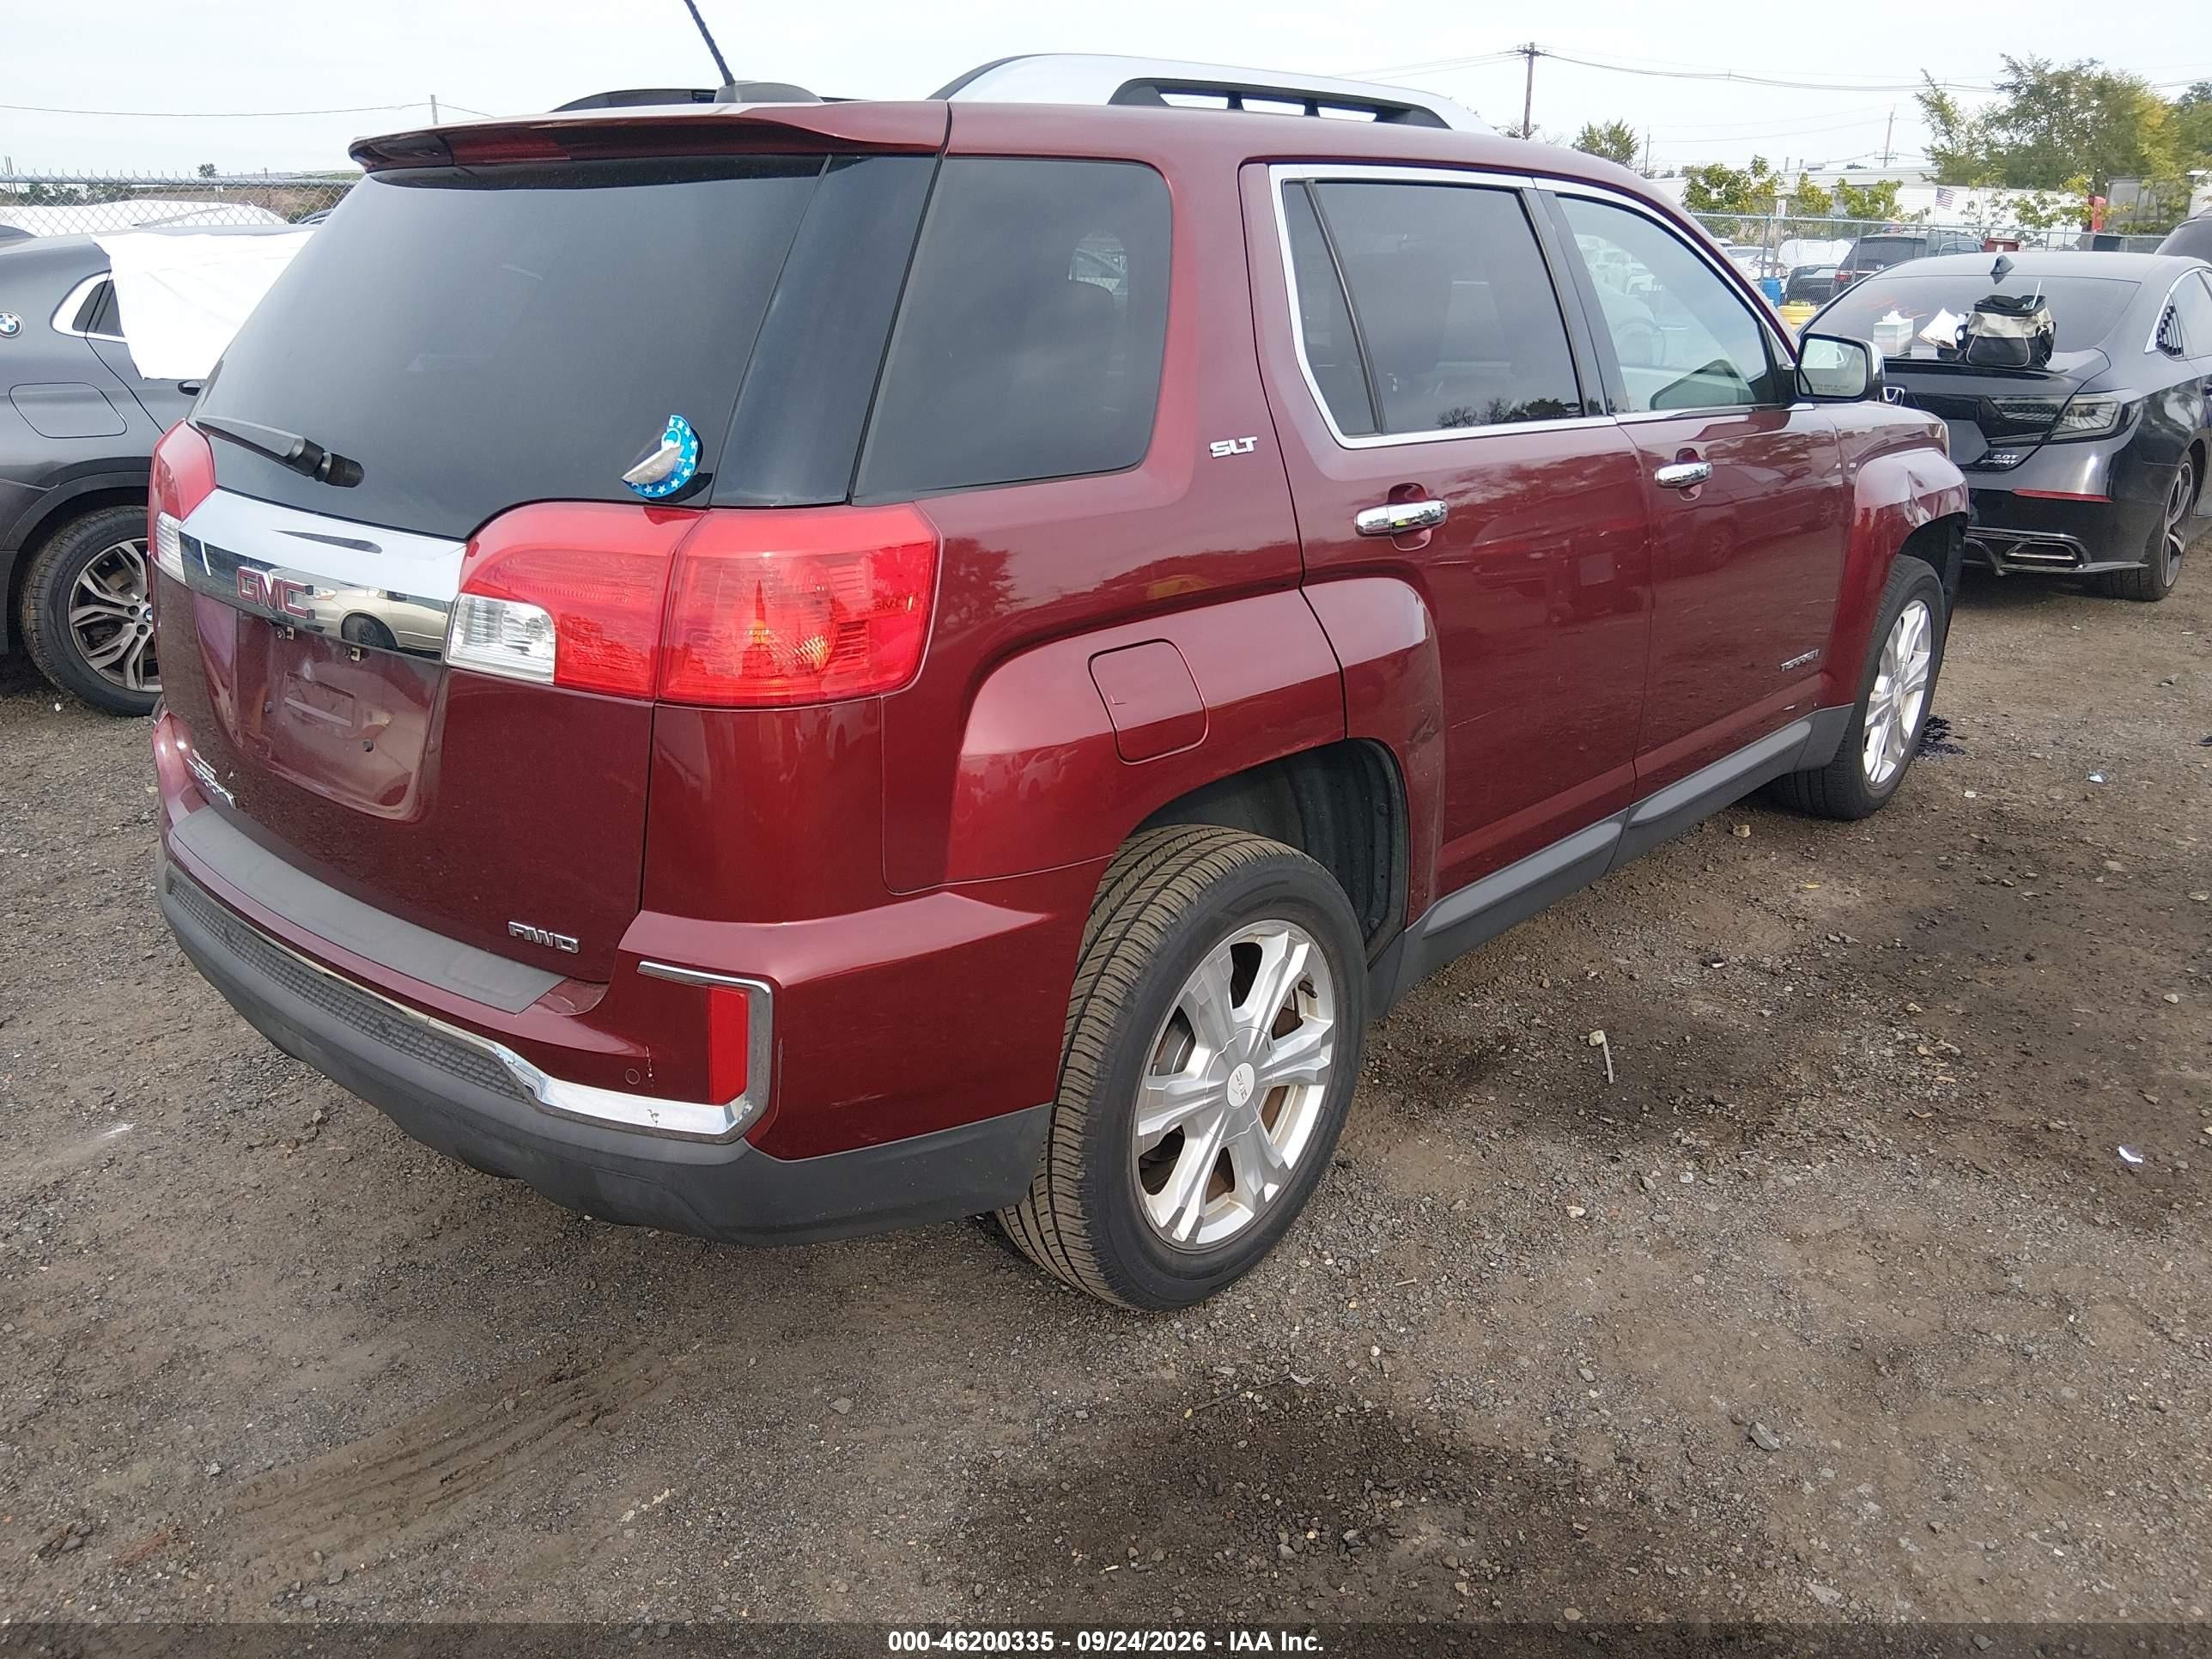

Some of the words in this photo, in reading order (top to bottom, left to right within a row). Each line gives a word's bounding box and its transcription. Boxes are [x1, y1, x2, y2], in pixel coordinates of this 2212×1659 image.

[1209, 436, 1258, 458] SLT
[237, 566, 315, 619] GMC
[507, 921, 580, 954] AWD
